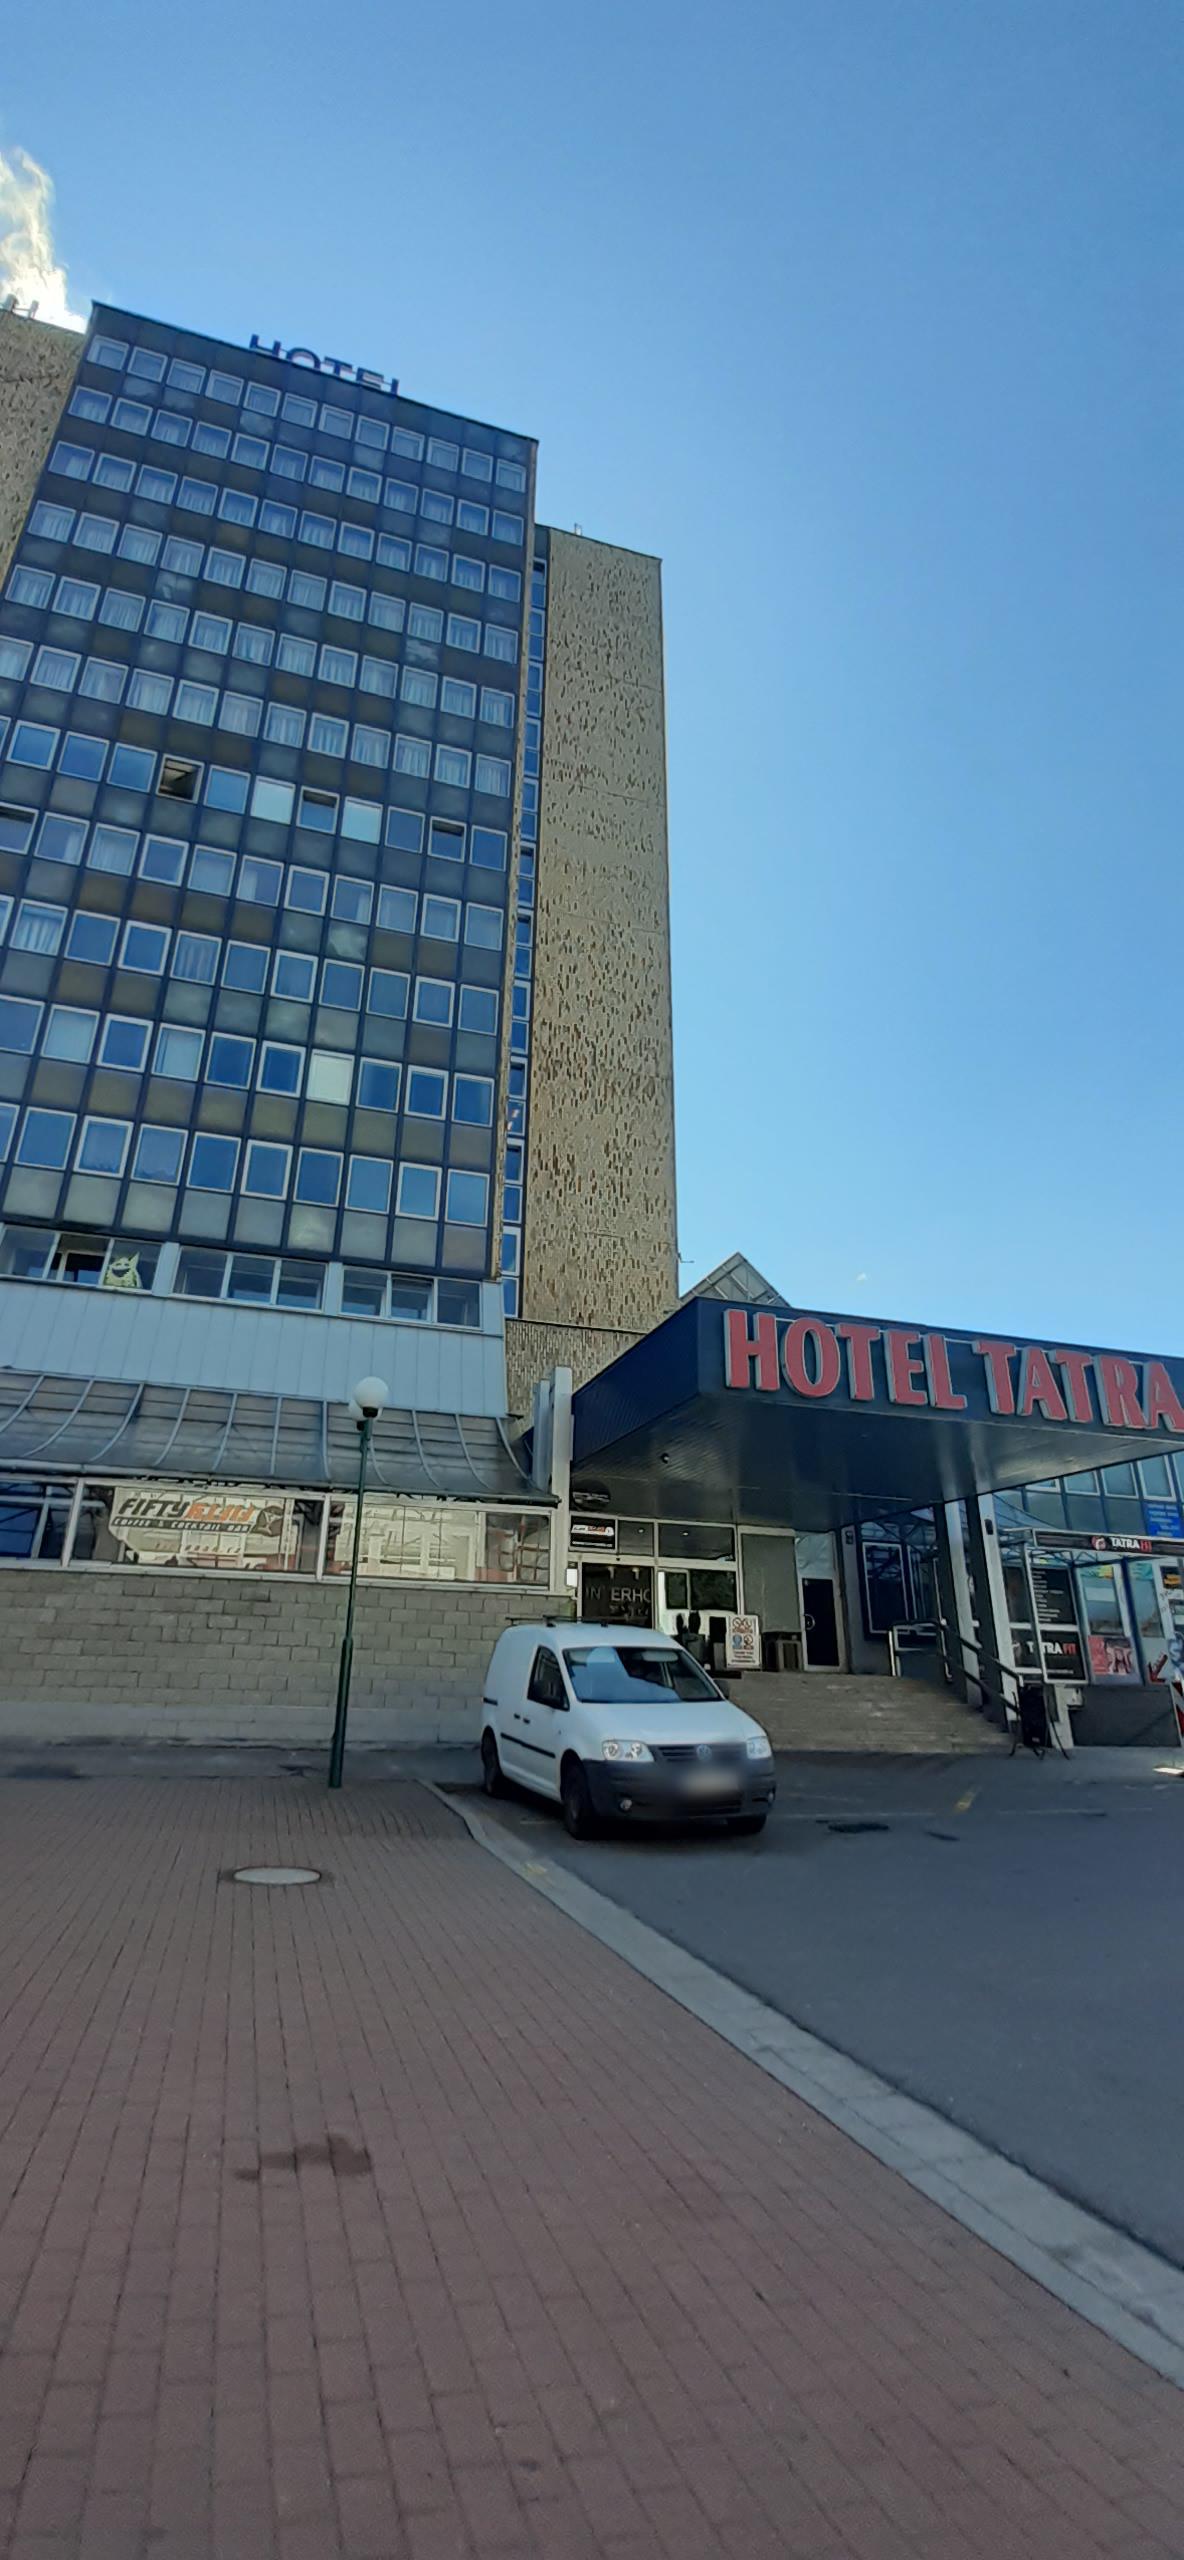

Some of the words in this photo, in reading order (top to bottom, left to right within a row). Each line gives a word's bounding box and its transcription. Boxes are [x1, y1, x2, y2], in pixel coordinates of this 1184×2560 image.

[724, 1309, 968, 1411] HOTEL
[972, 1338, 1184, 1433] TATRA
[1026, 1641, 1063, 1655] TTRA
